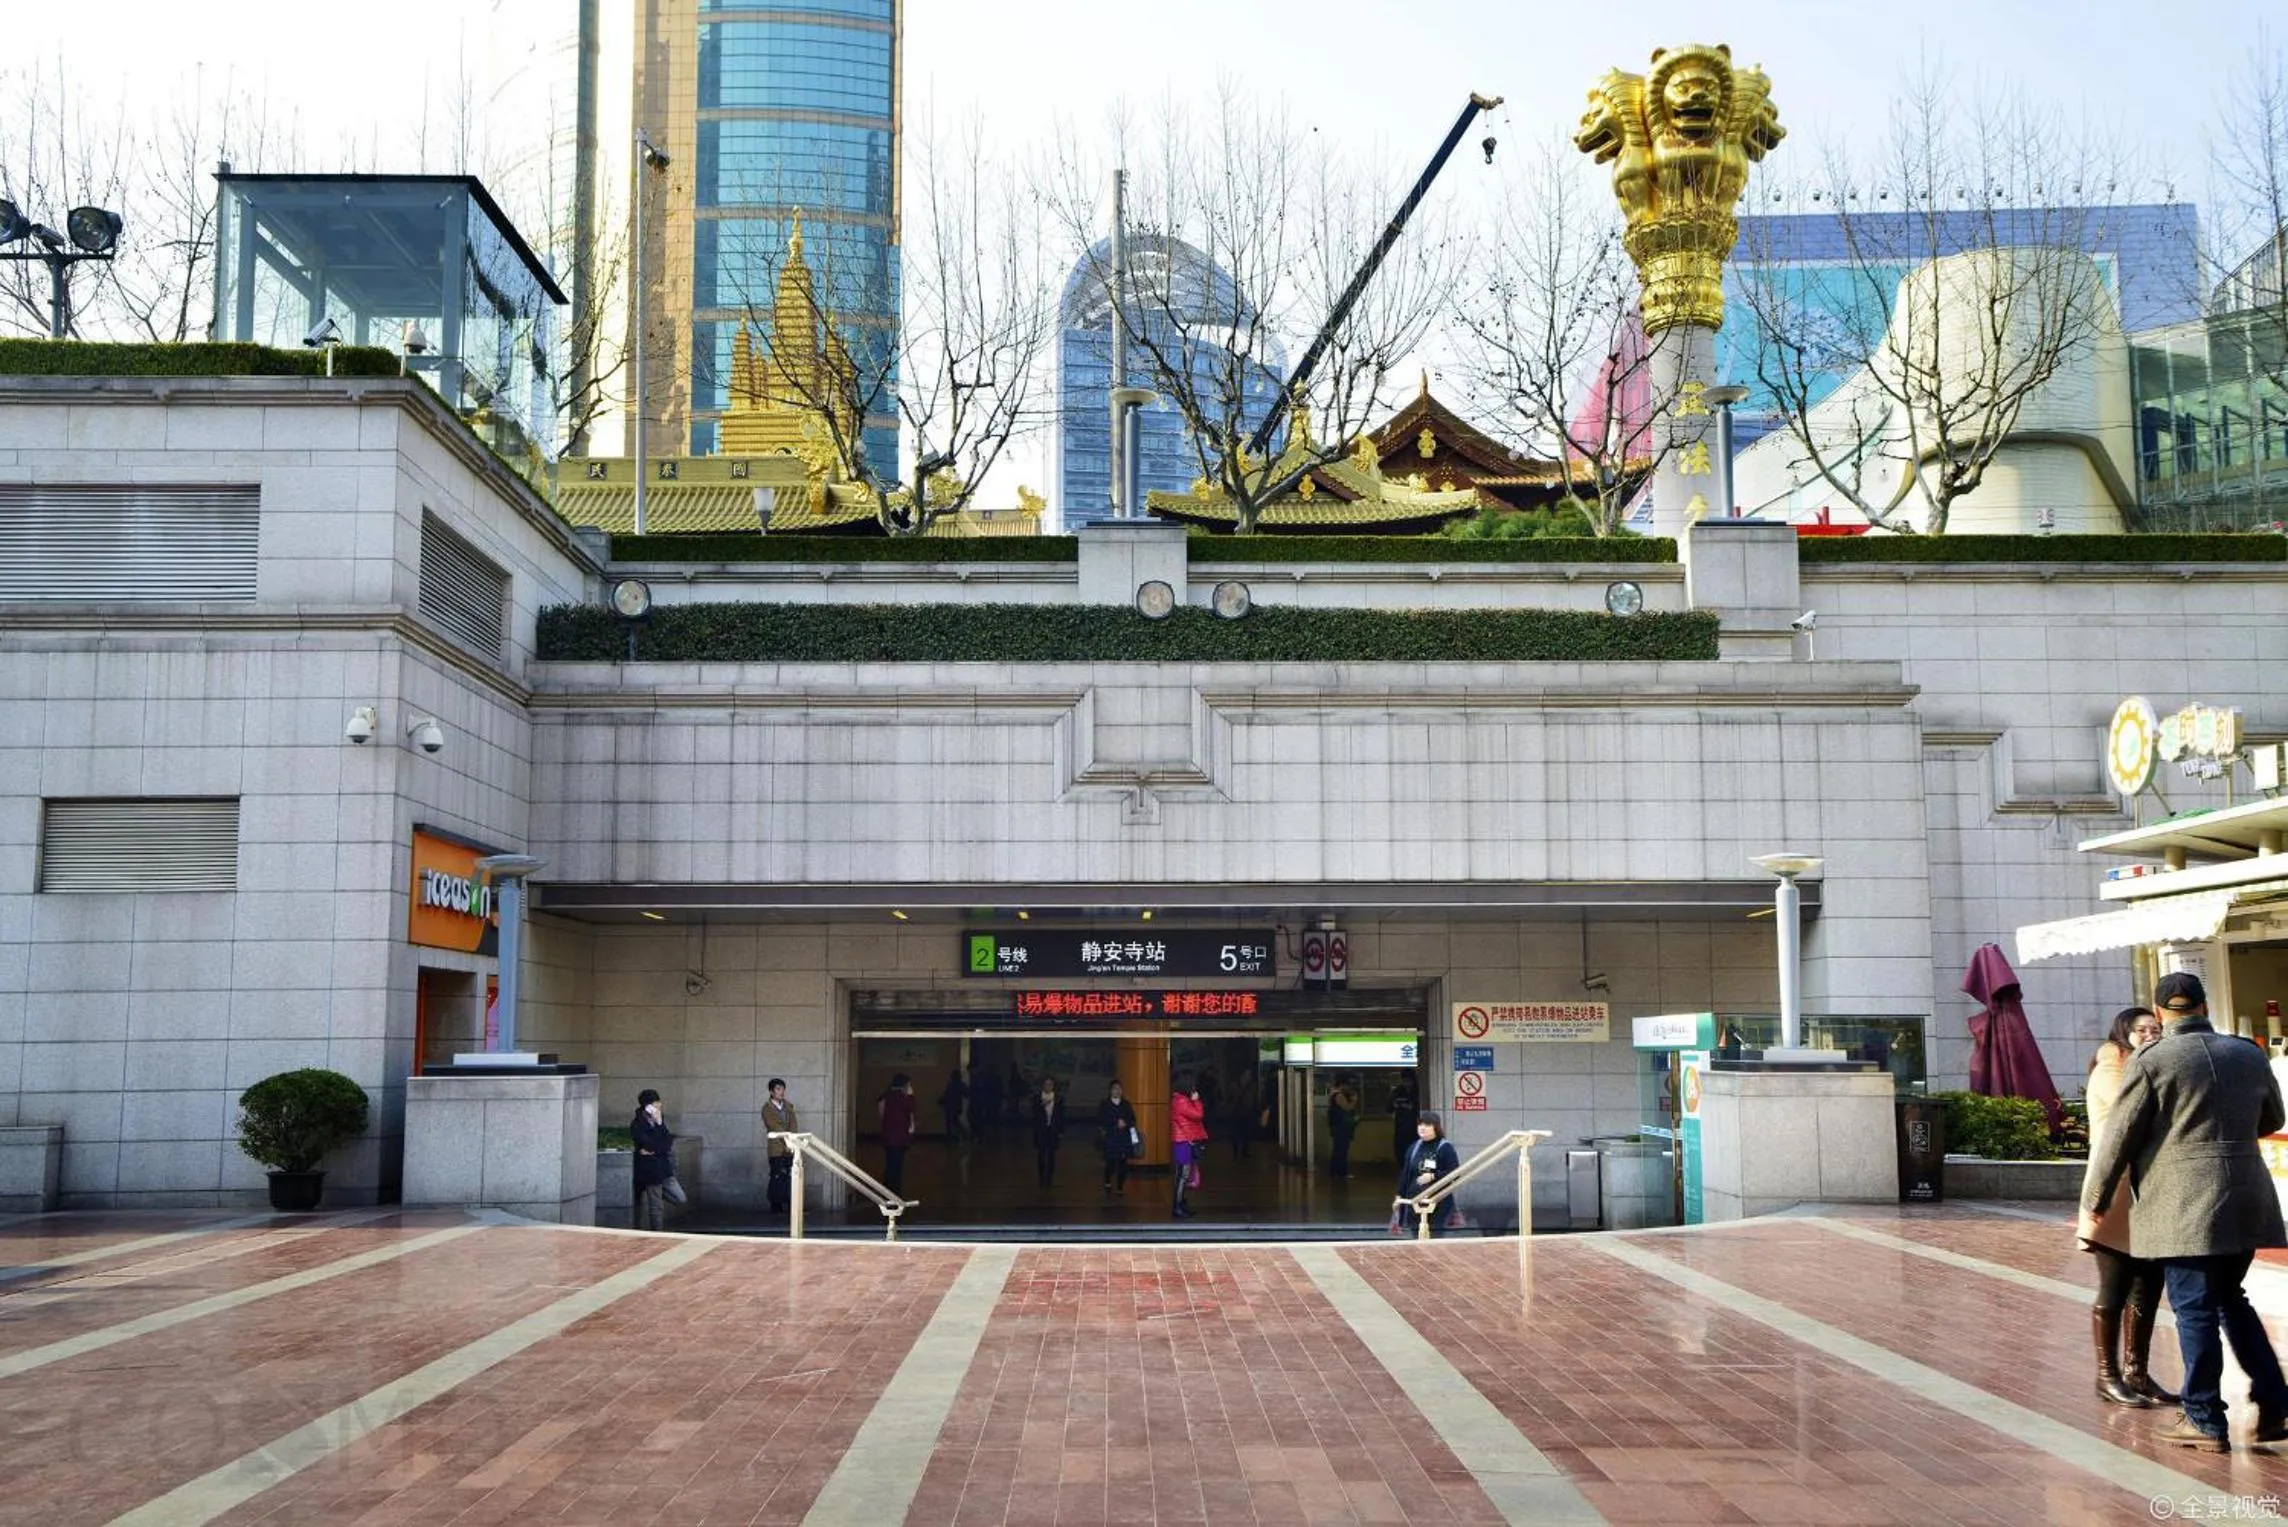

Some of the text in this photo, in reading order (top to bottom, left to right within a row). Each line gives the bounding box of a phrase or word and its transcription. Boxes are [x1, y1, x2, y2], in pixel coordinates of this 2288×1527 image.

[1081, 940, 1166, 962] 静安寺站
[1240, 962, 1261, 971] EXIT
[1400, 1044, 1417, 1059] 全
